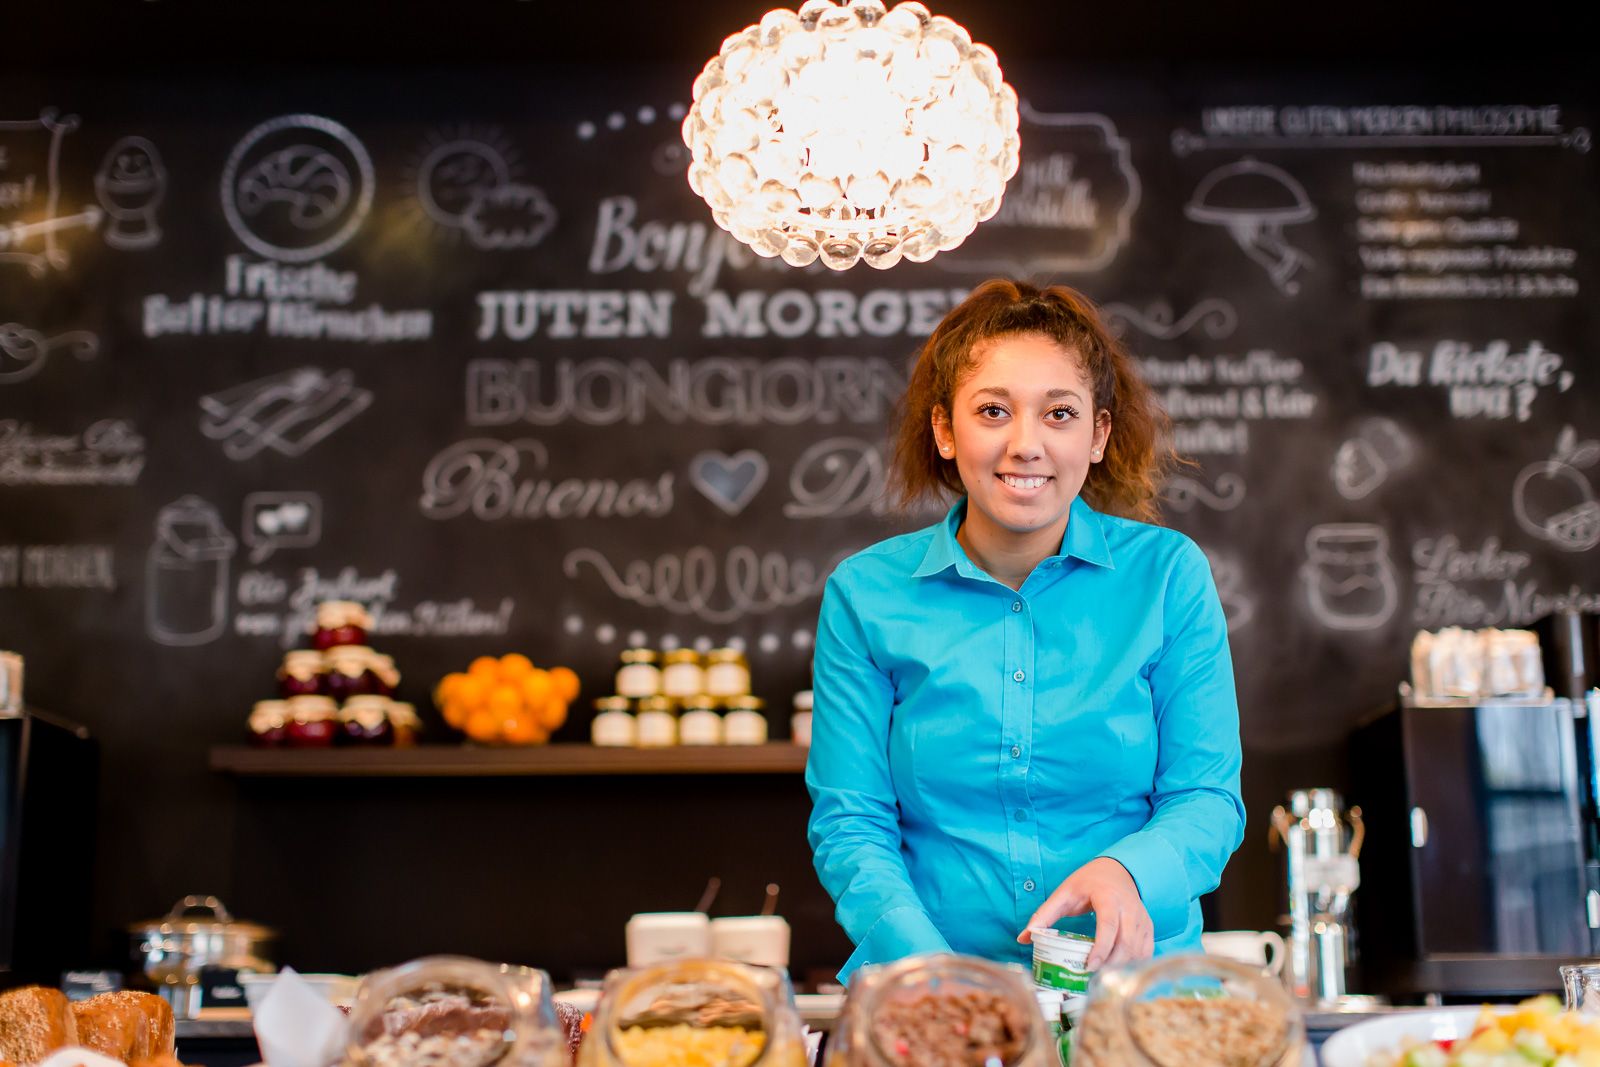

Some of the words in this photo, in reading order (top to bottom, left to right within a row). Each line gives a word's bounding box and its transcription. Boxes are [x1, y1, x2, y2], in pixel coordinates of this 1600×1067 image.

[475, 290, 673, 339] JUTEN
[703, 289, 970, 337] MORGE
[466, 356, 917, 424] BUONGIORN
[420, 439, 676, 520] Buenos
